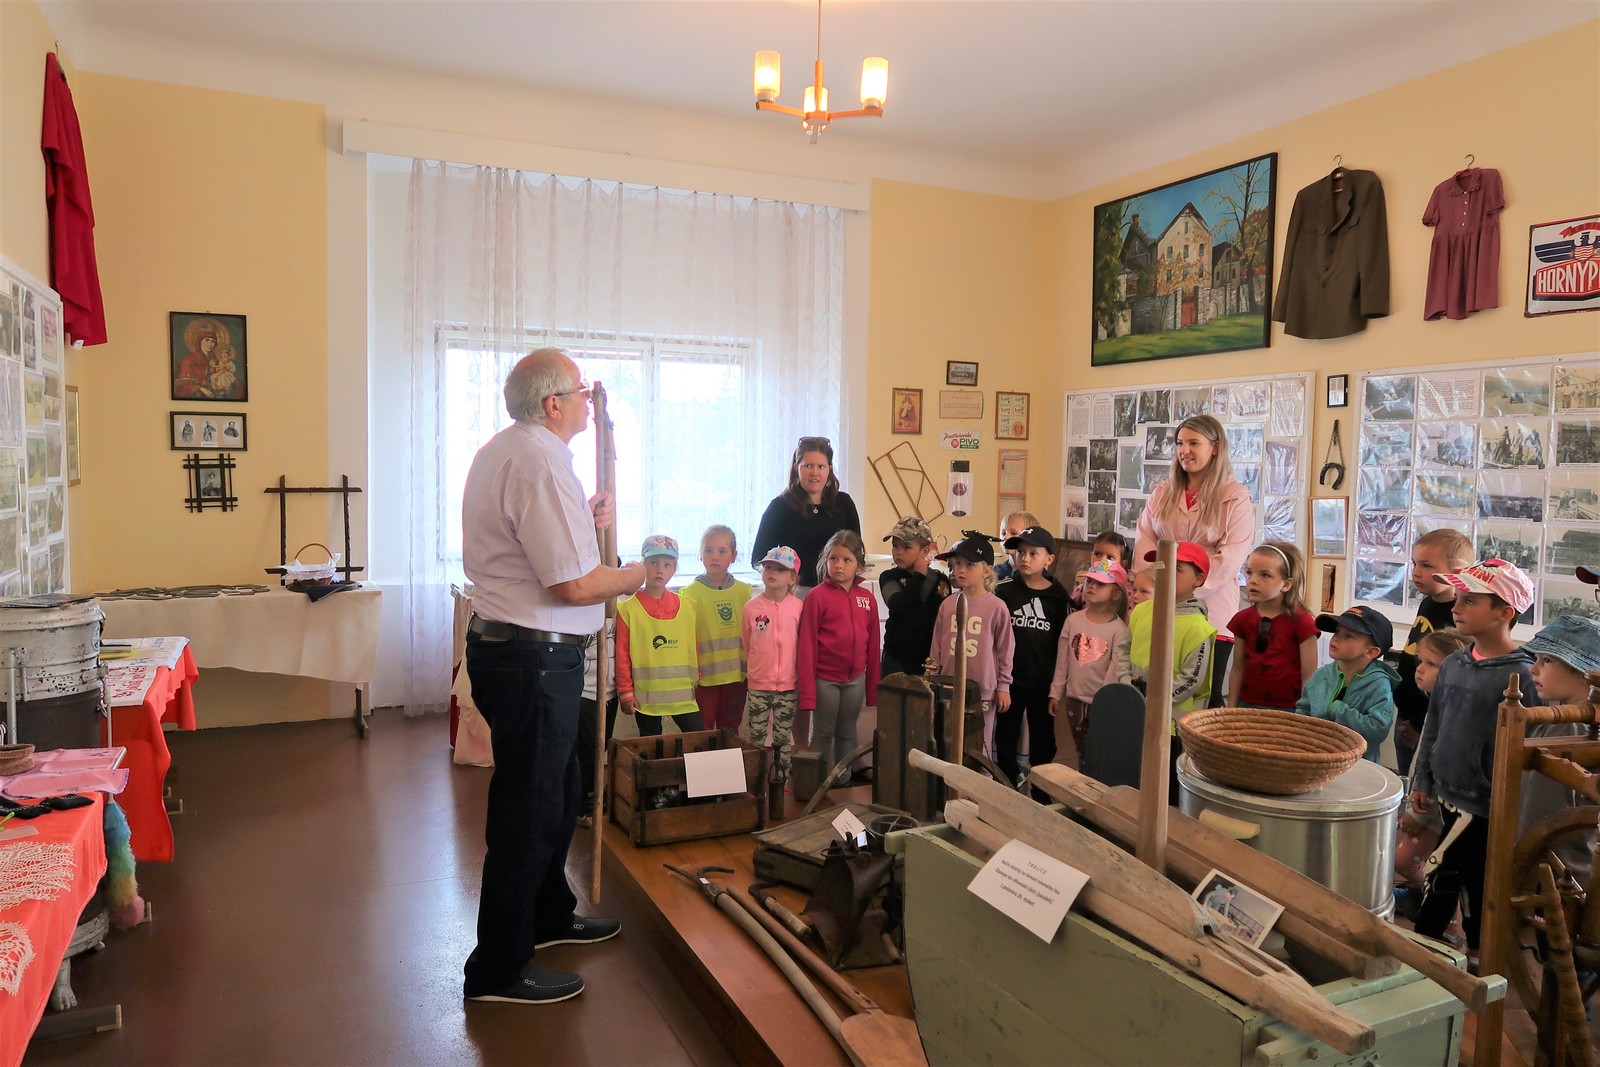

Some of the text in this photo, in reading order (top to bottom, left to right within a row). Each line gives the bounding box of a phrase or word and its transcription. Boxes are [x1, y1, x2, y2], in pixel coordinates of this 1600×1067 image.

[1538, 260, 1600, 293] HORNYP
[856, 599, 871, 609] SIX
[1010, 616, 1051, 631] adidas
